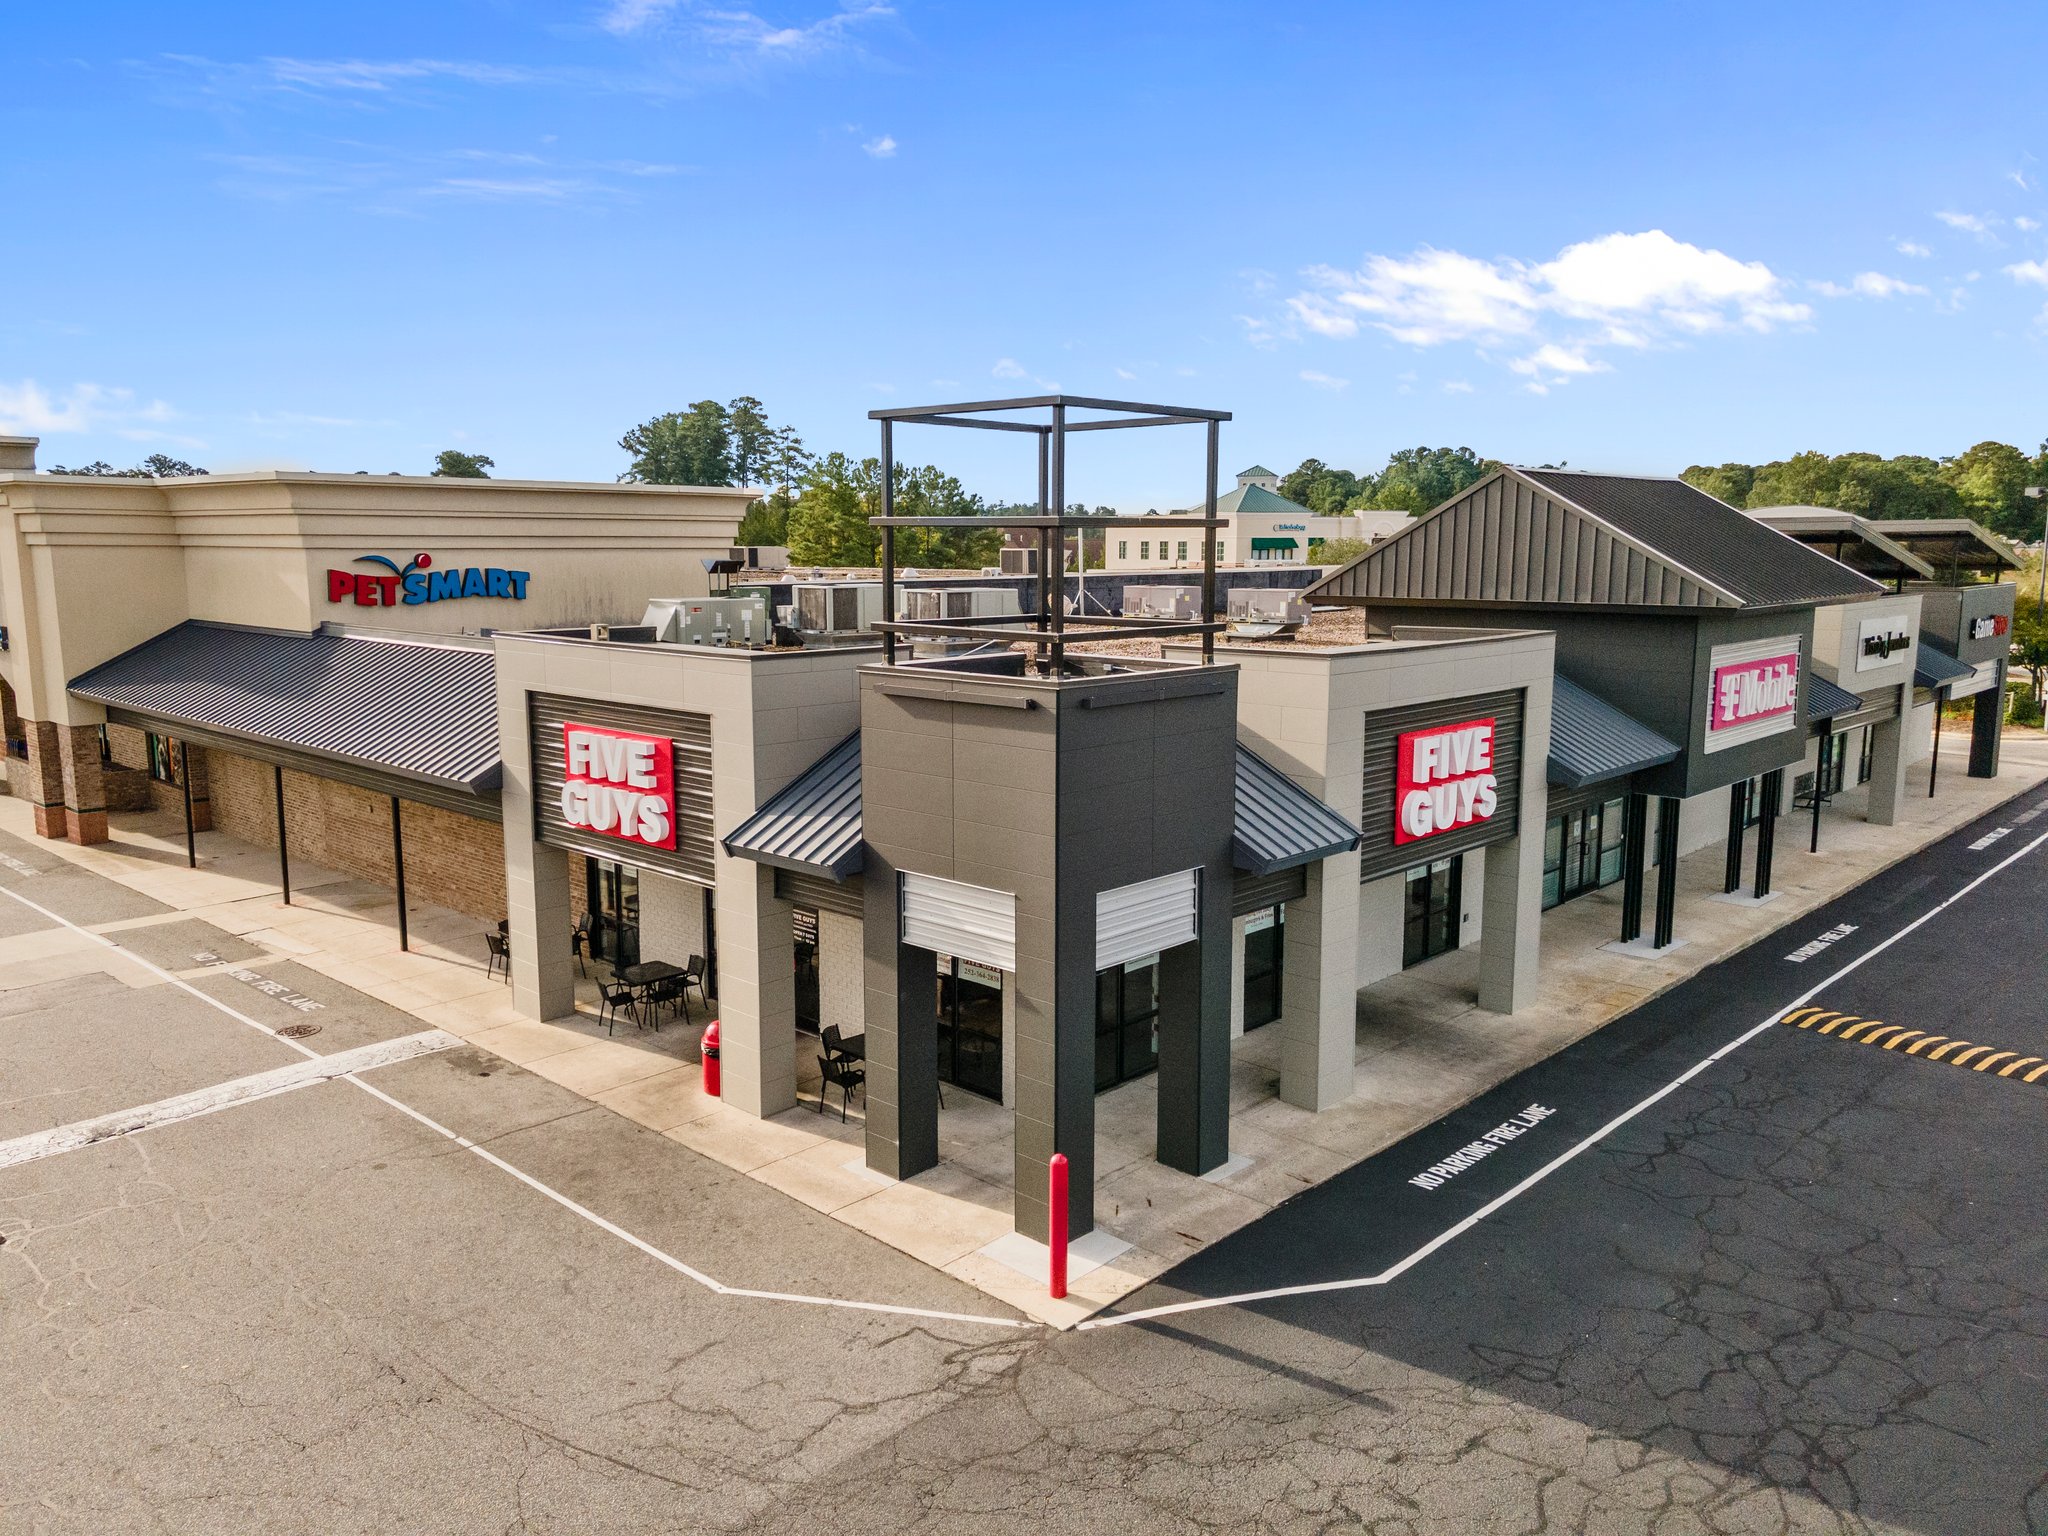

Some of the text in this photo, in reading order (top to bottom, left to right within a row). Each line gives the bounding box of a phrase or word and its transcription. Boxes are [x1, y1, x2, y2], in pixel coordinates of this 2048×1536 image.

[567, 730, 658, 789] FIVE
[1412, 725, 1492, 784] FIVE
[561, 779, 670, 843] GUYS
[1401, 773, 1498, 837] GUYS
[250, 979, 291, 996] FIRE
[279, 992, 327, 1012] LANE
[1408, 1103, 1558, 1191] NO PARKING FIRE LANE
